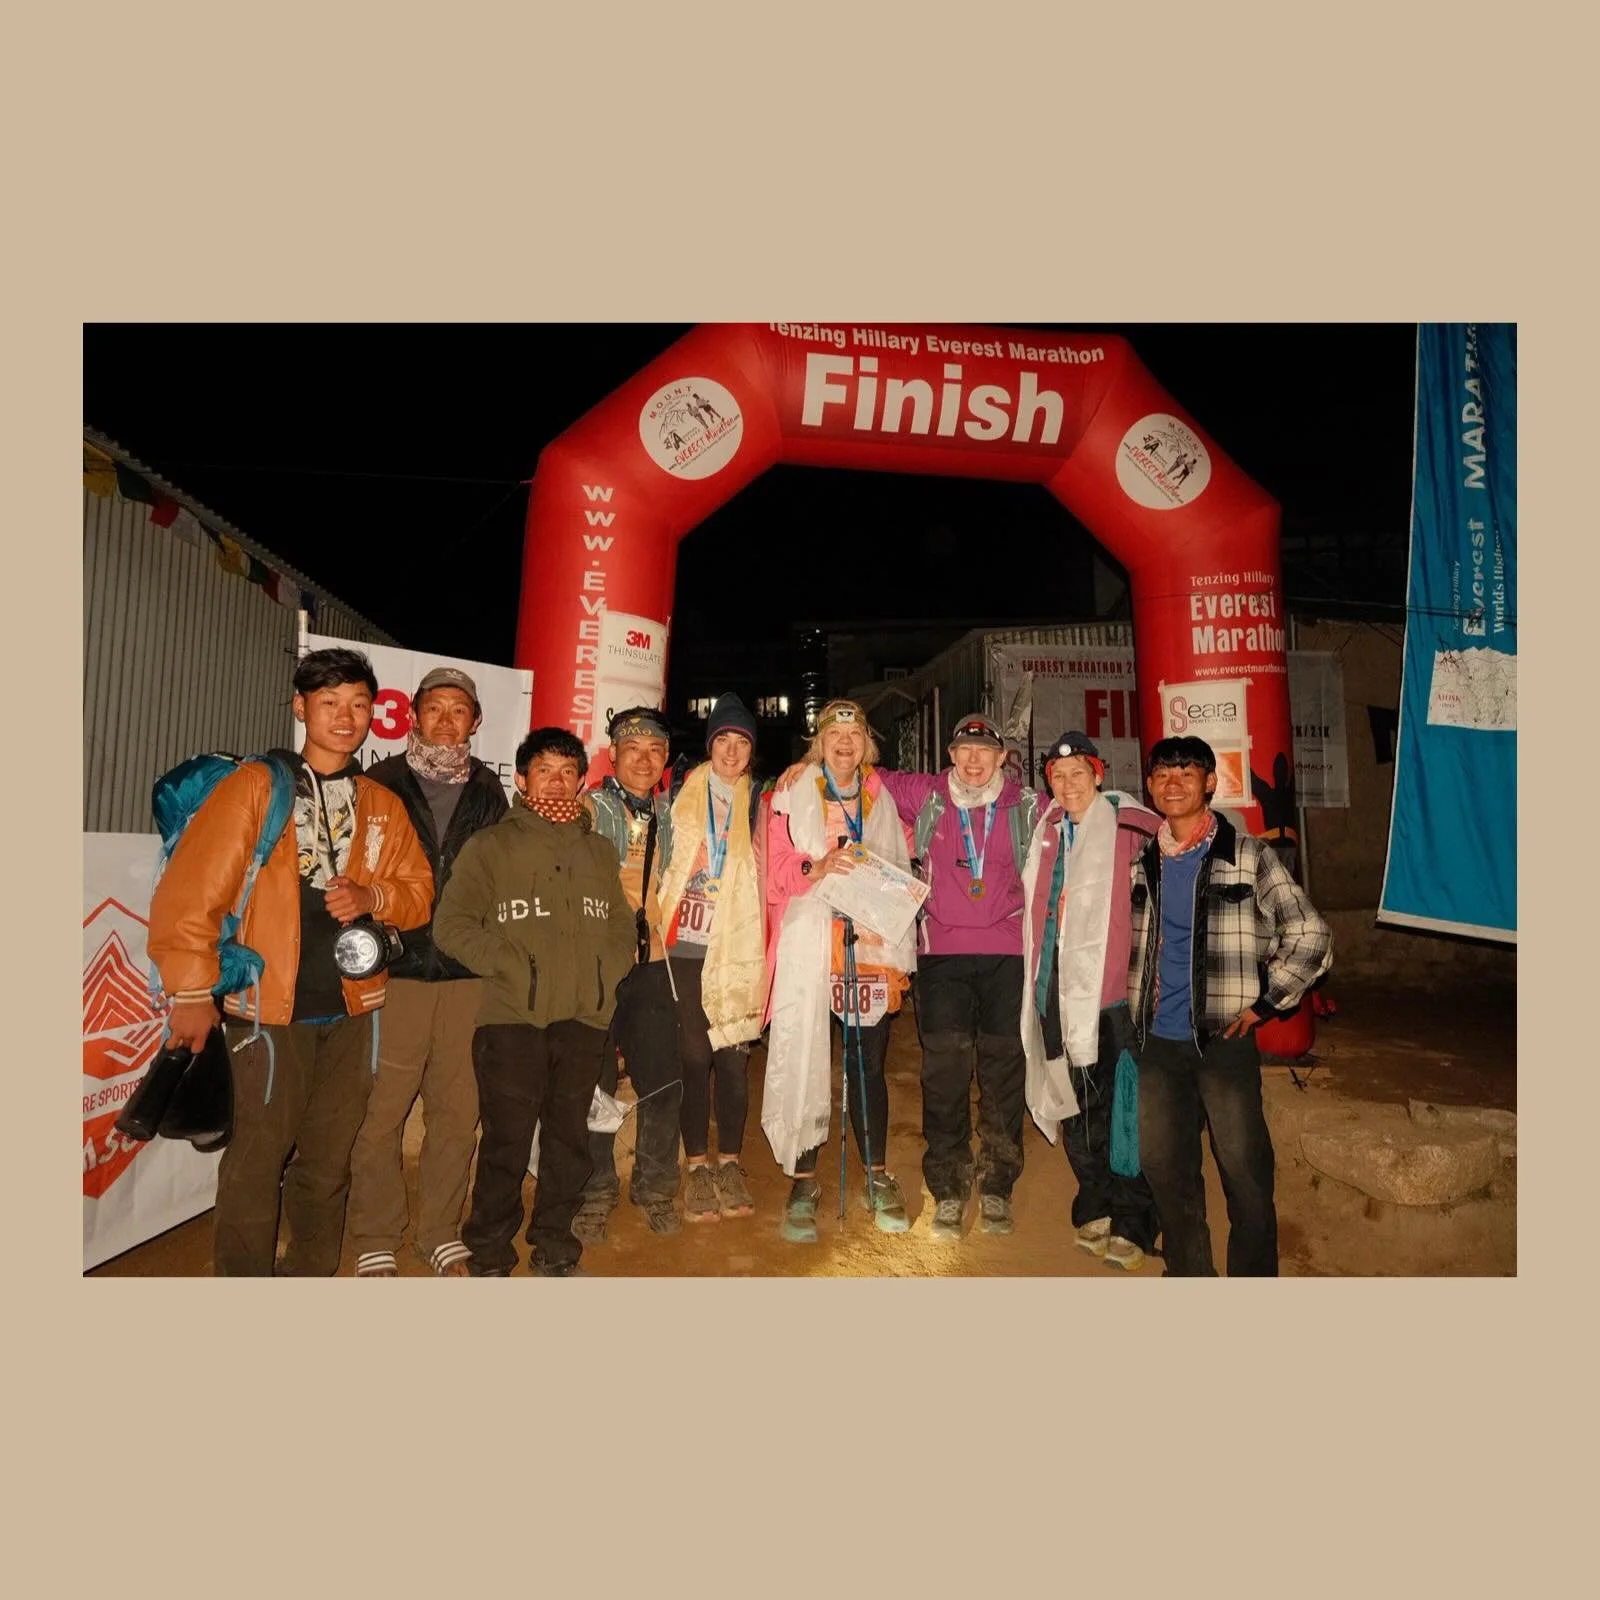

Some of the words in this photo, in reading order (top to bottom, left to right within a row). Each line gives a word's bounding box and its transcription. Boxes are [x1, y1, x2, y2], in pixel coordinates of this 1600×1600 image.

[852, 327, 920, 356] Hillary
[926, 335, 1003, 358] Everest
[1008, 342, 1105, 365] Marathon
[801, 351, 1065, 445] Finish
[1190, 571, 1240, 587] Tenzing
[1243, 569, 1276, 586] Hillary
[625, 629, 651, 650] 3M
[608, 644, 663, 665] THINSULATE
[1022, 659, 1066, 674] EVEREST
[1068, 660, 1123, 675] MARATHON
[1169, 695, 1238, 734] Seara
